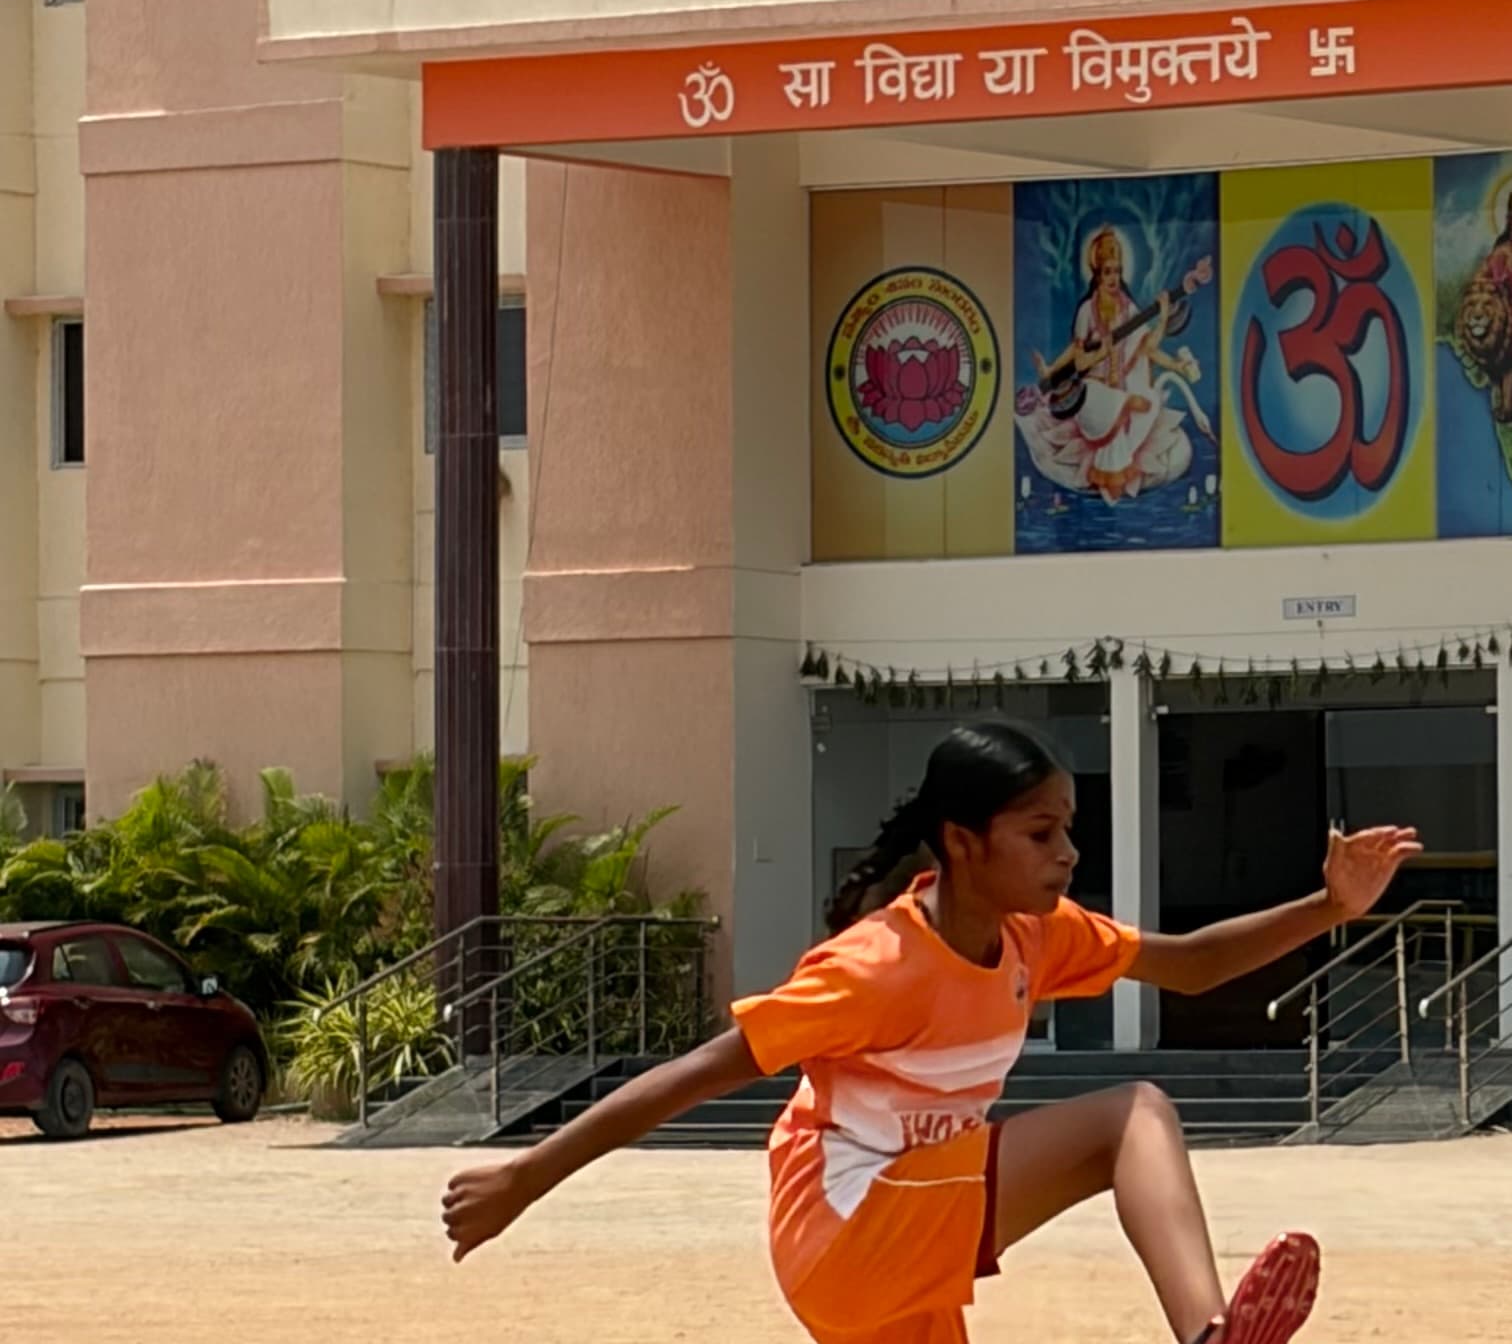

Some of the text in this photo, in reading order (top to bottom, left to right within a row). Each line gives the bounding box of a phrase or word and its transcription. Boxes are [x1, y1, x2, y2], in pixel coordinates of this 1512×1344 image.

[778, 61, 836, 108] सा
[854, 43, 963, 104] विद्या
[979, 47, 1048, 95] या
[1062, 16, 1271, 104] विमुक्तये
[1296, 599, 1344, 614] ENTRY
